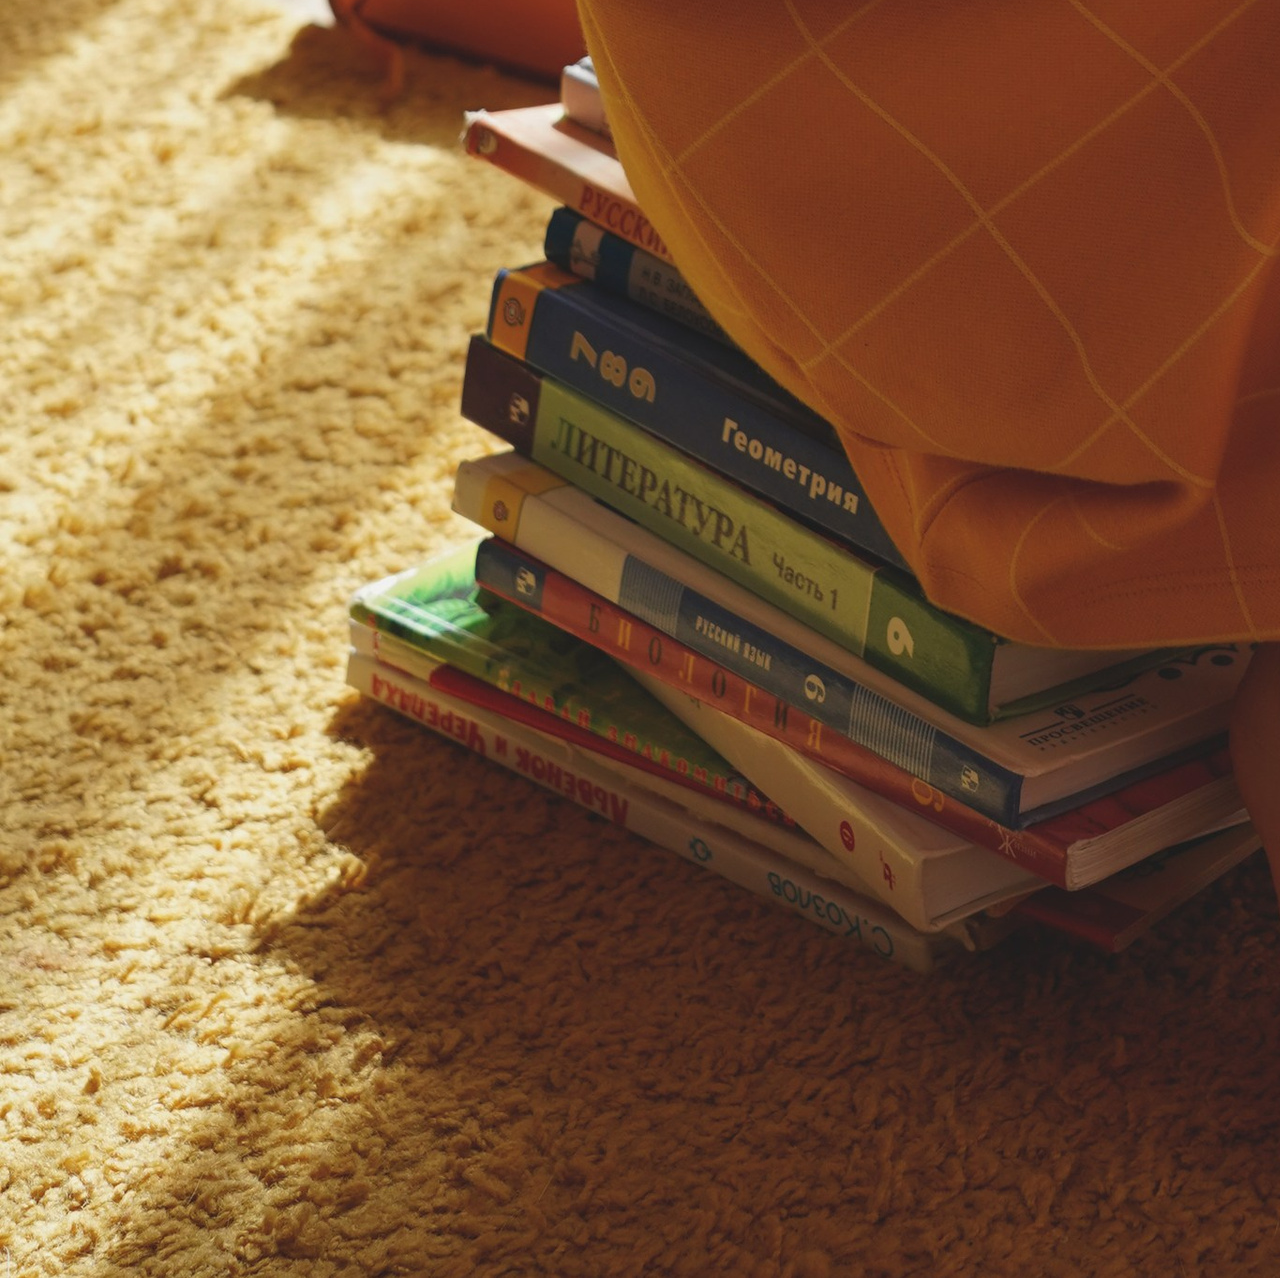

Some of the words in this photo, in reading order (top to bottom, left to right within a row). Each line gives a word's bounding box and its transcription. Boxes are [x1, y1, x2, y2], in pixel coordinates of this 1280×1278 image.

[579, 185, 667, 255] РУССКИ
[551, 417, 753, 567] ЛИТЕРАТУРА
[722, 417, 859, 515] Геометрия
[773, 551, 824, 602] Часть
[830, 588, 838, 611] 1
[695, 615, 740, 654] РУССКИЙ
[743, 642, 772, 671] ЯЗЫК
[1028, 697, 1150, 747] ПРОСВЕЩЕНИЕ
